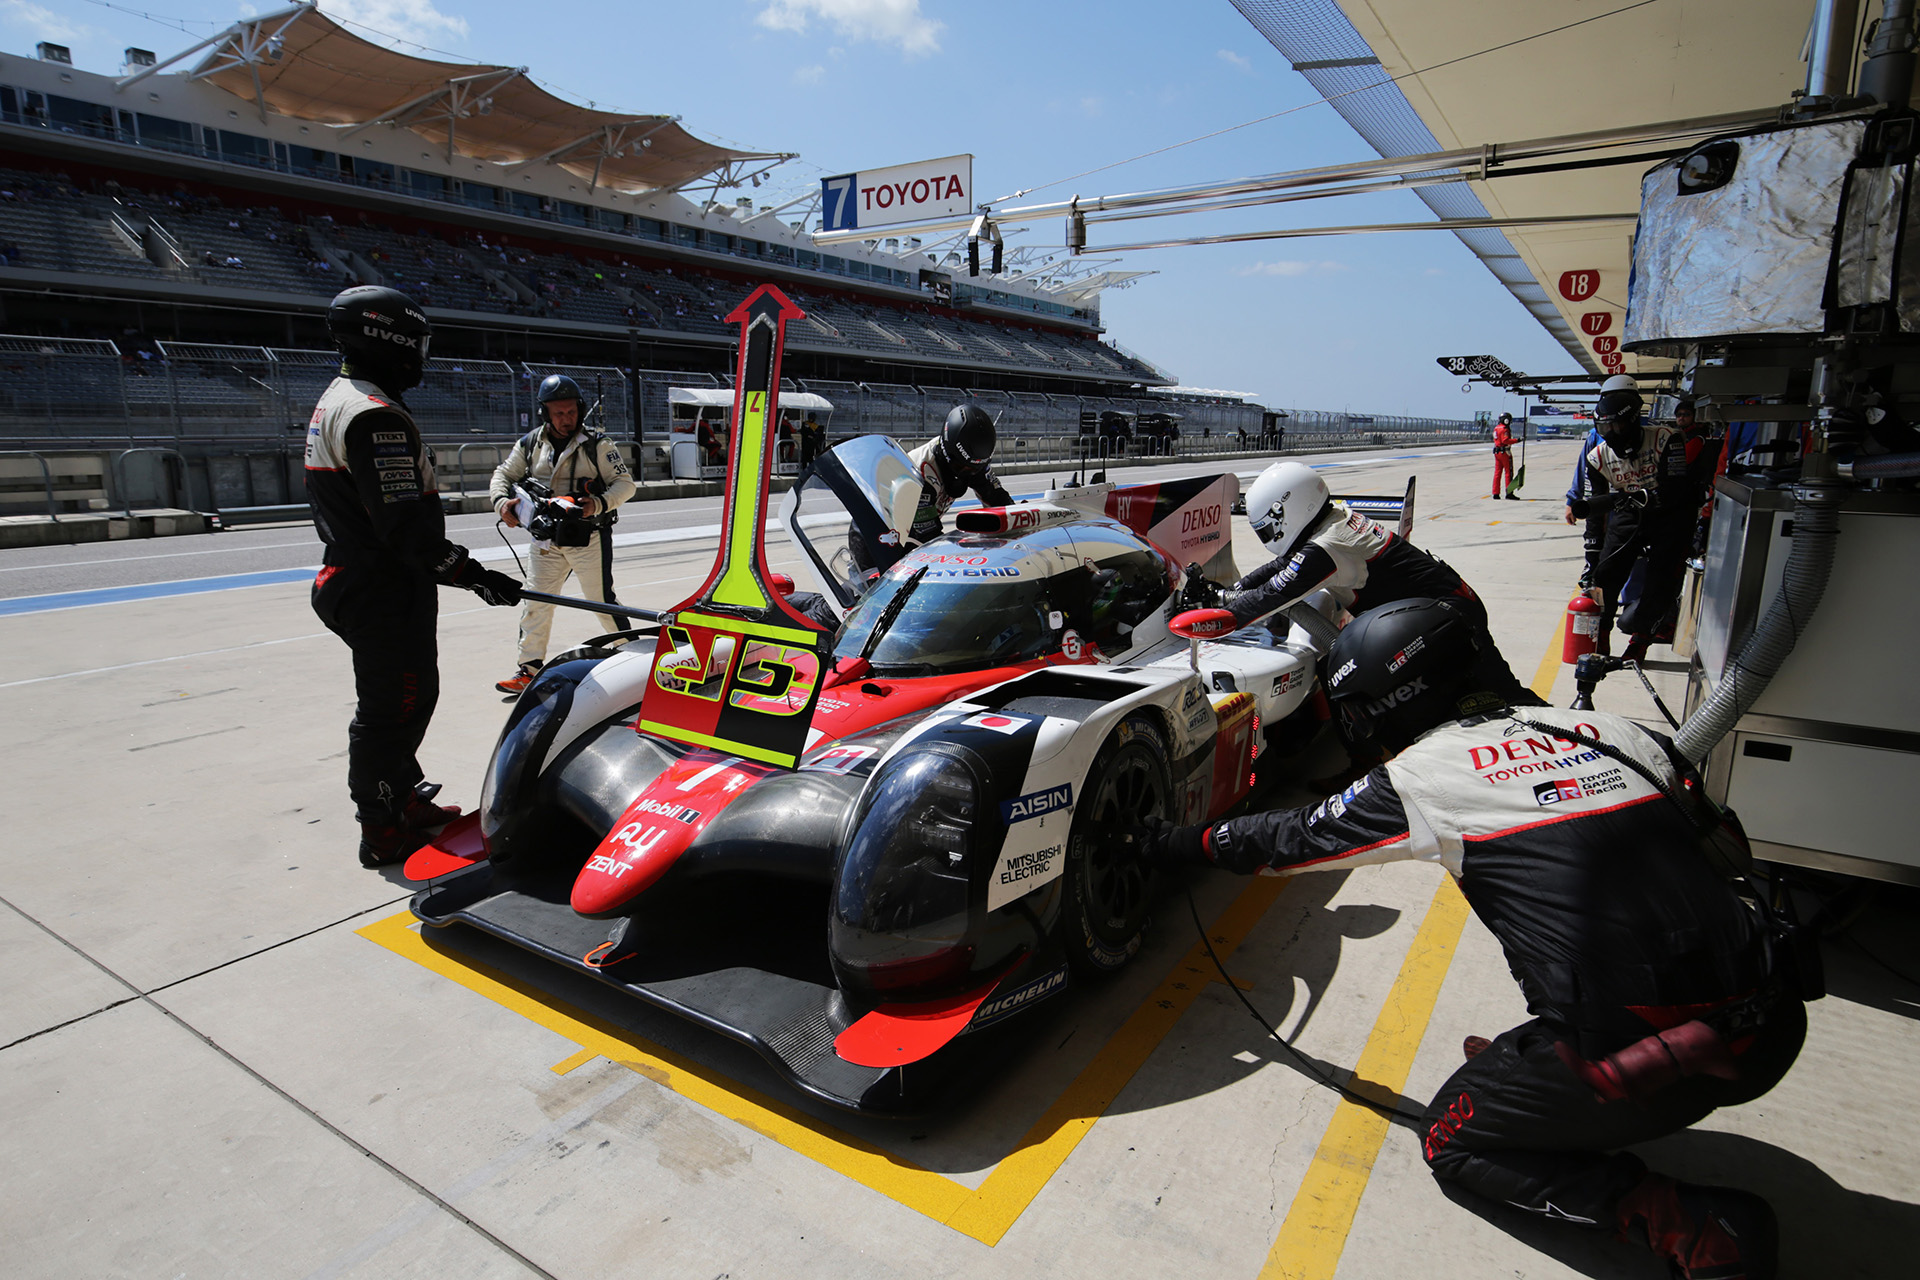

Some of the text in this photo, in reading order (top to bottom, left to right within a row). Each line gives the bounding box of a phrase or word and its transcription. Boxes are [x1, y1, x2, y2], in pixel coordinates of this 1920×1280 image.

[827, 174, 964, 228] 7 TOYOTA
[1570, 274, 1589, 295] 18
[405, 307, 427, 324] uvex
[1590, 315, 1605, 331] 17
[363, 325, 418, 349] uvex
[1600, 338, 1611, 352] 16
[1448, 357, 1465, 371] 38
[1607, 354, 1617, 365] 15
[375, 434, 404, 442] JTEKT
[955, 442, 971, 461] uvex
[1117, 496, 1132, 520] HY
[1010, 508, 1040, 530] ZENT
[1182, 504, 1221, 533] DENSO
[1181, 539, 1200, 549] TOYOTA
[909, 552, 989, 566] DENSO
[925, 566, 1021, 577] HYBRID
[1191, 621, 1216, 633] Mobil
[1066, 635, 1077, 655] E
[1331, 658, 1358, 688] uvex
[1389, 654, 1408, 672] GR
[1366, 675, 1430, 716] uvex
[1217, 694, 1250, 720] DHL
[1468, 722, 1600, 771] DENSO
[809, 749, 865, 769] P1
[1234, 724, 1250, 794] 7
[1483, 761, 1556, 784] TOYOTA
[1578, 768, 1622, 784] TOYOTA
[1582, 775, 1623, 790] GAZOO
[1586, 782, 1628, 797] Racing
[635, 799, 684, 818] Mobil
[1010, 788, 1068, 819] AISIN
[585, 855, 634, 879] ZENT
[1007, 844, 1062, 870] MITSUBISHI
[1001, 861, 1051, 885] ELECTRIC
[976, 971, 1065, 1018] MICHELIN
[1425, 1092, 1474, 1160] DENSO
